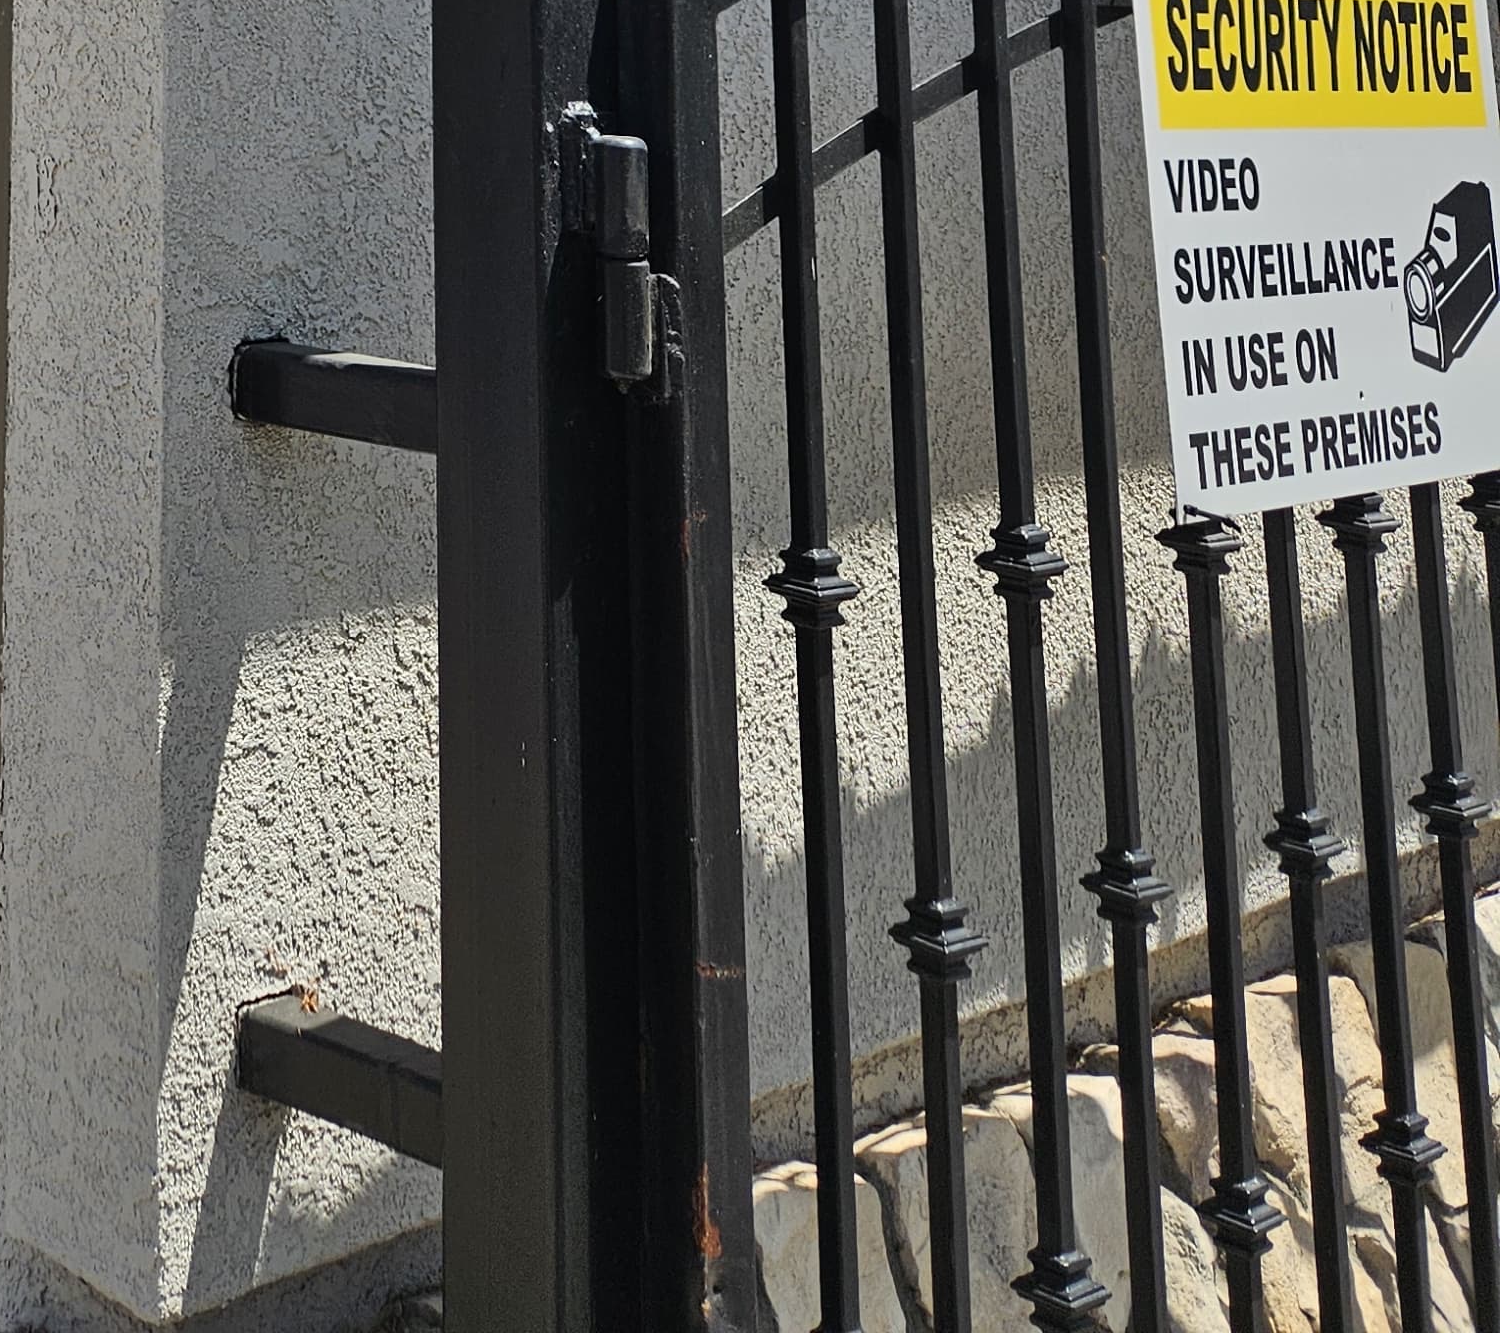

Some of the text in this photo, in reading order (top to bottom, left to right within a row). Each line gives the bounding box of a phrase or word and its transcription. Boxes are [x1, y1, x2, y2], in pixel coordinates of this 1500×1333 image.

[1164, 157, 1260, 213] VIDEO
[1174, 237, 1399, 305] SURVEILLANCE
[1181, 326, 1339, 396] IN USE ON
[1189, 401, 1442, 490] THESE PREMISES
